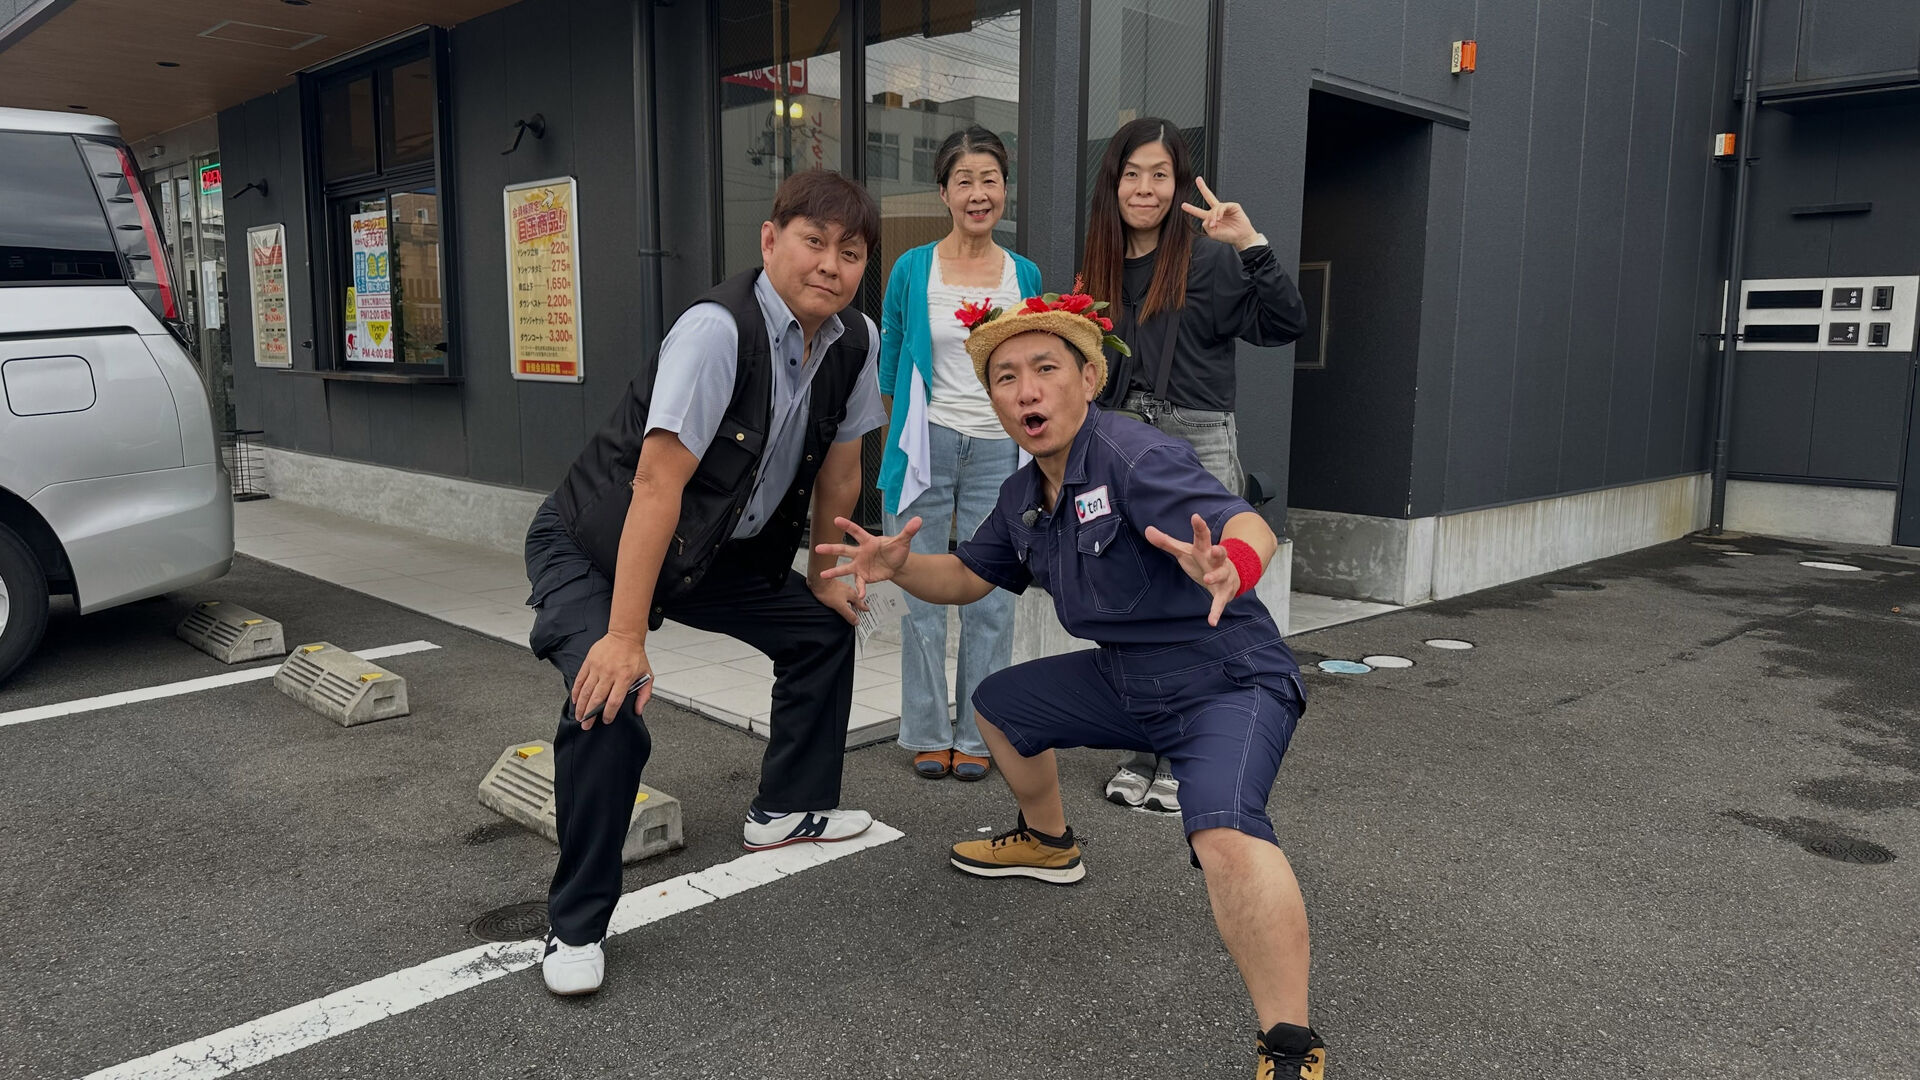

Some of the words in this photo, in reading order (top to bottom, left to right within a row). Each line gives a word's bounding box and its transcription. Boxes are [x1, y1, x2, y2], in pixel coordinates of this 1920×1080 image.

[551, 241, 569, 254] 220円
[552, 259, 570, 272] 275円
[547, 277, 571, 291] 1,650円
[547, 294, 572, 308] 2,200円
[547, 312, 572, 325] 2,750円
[549, 329, 573, 342] 3,300円
